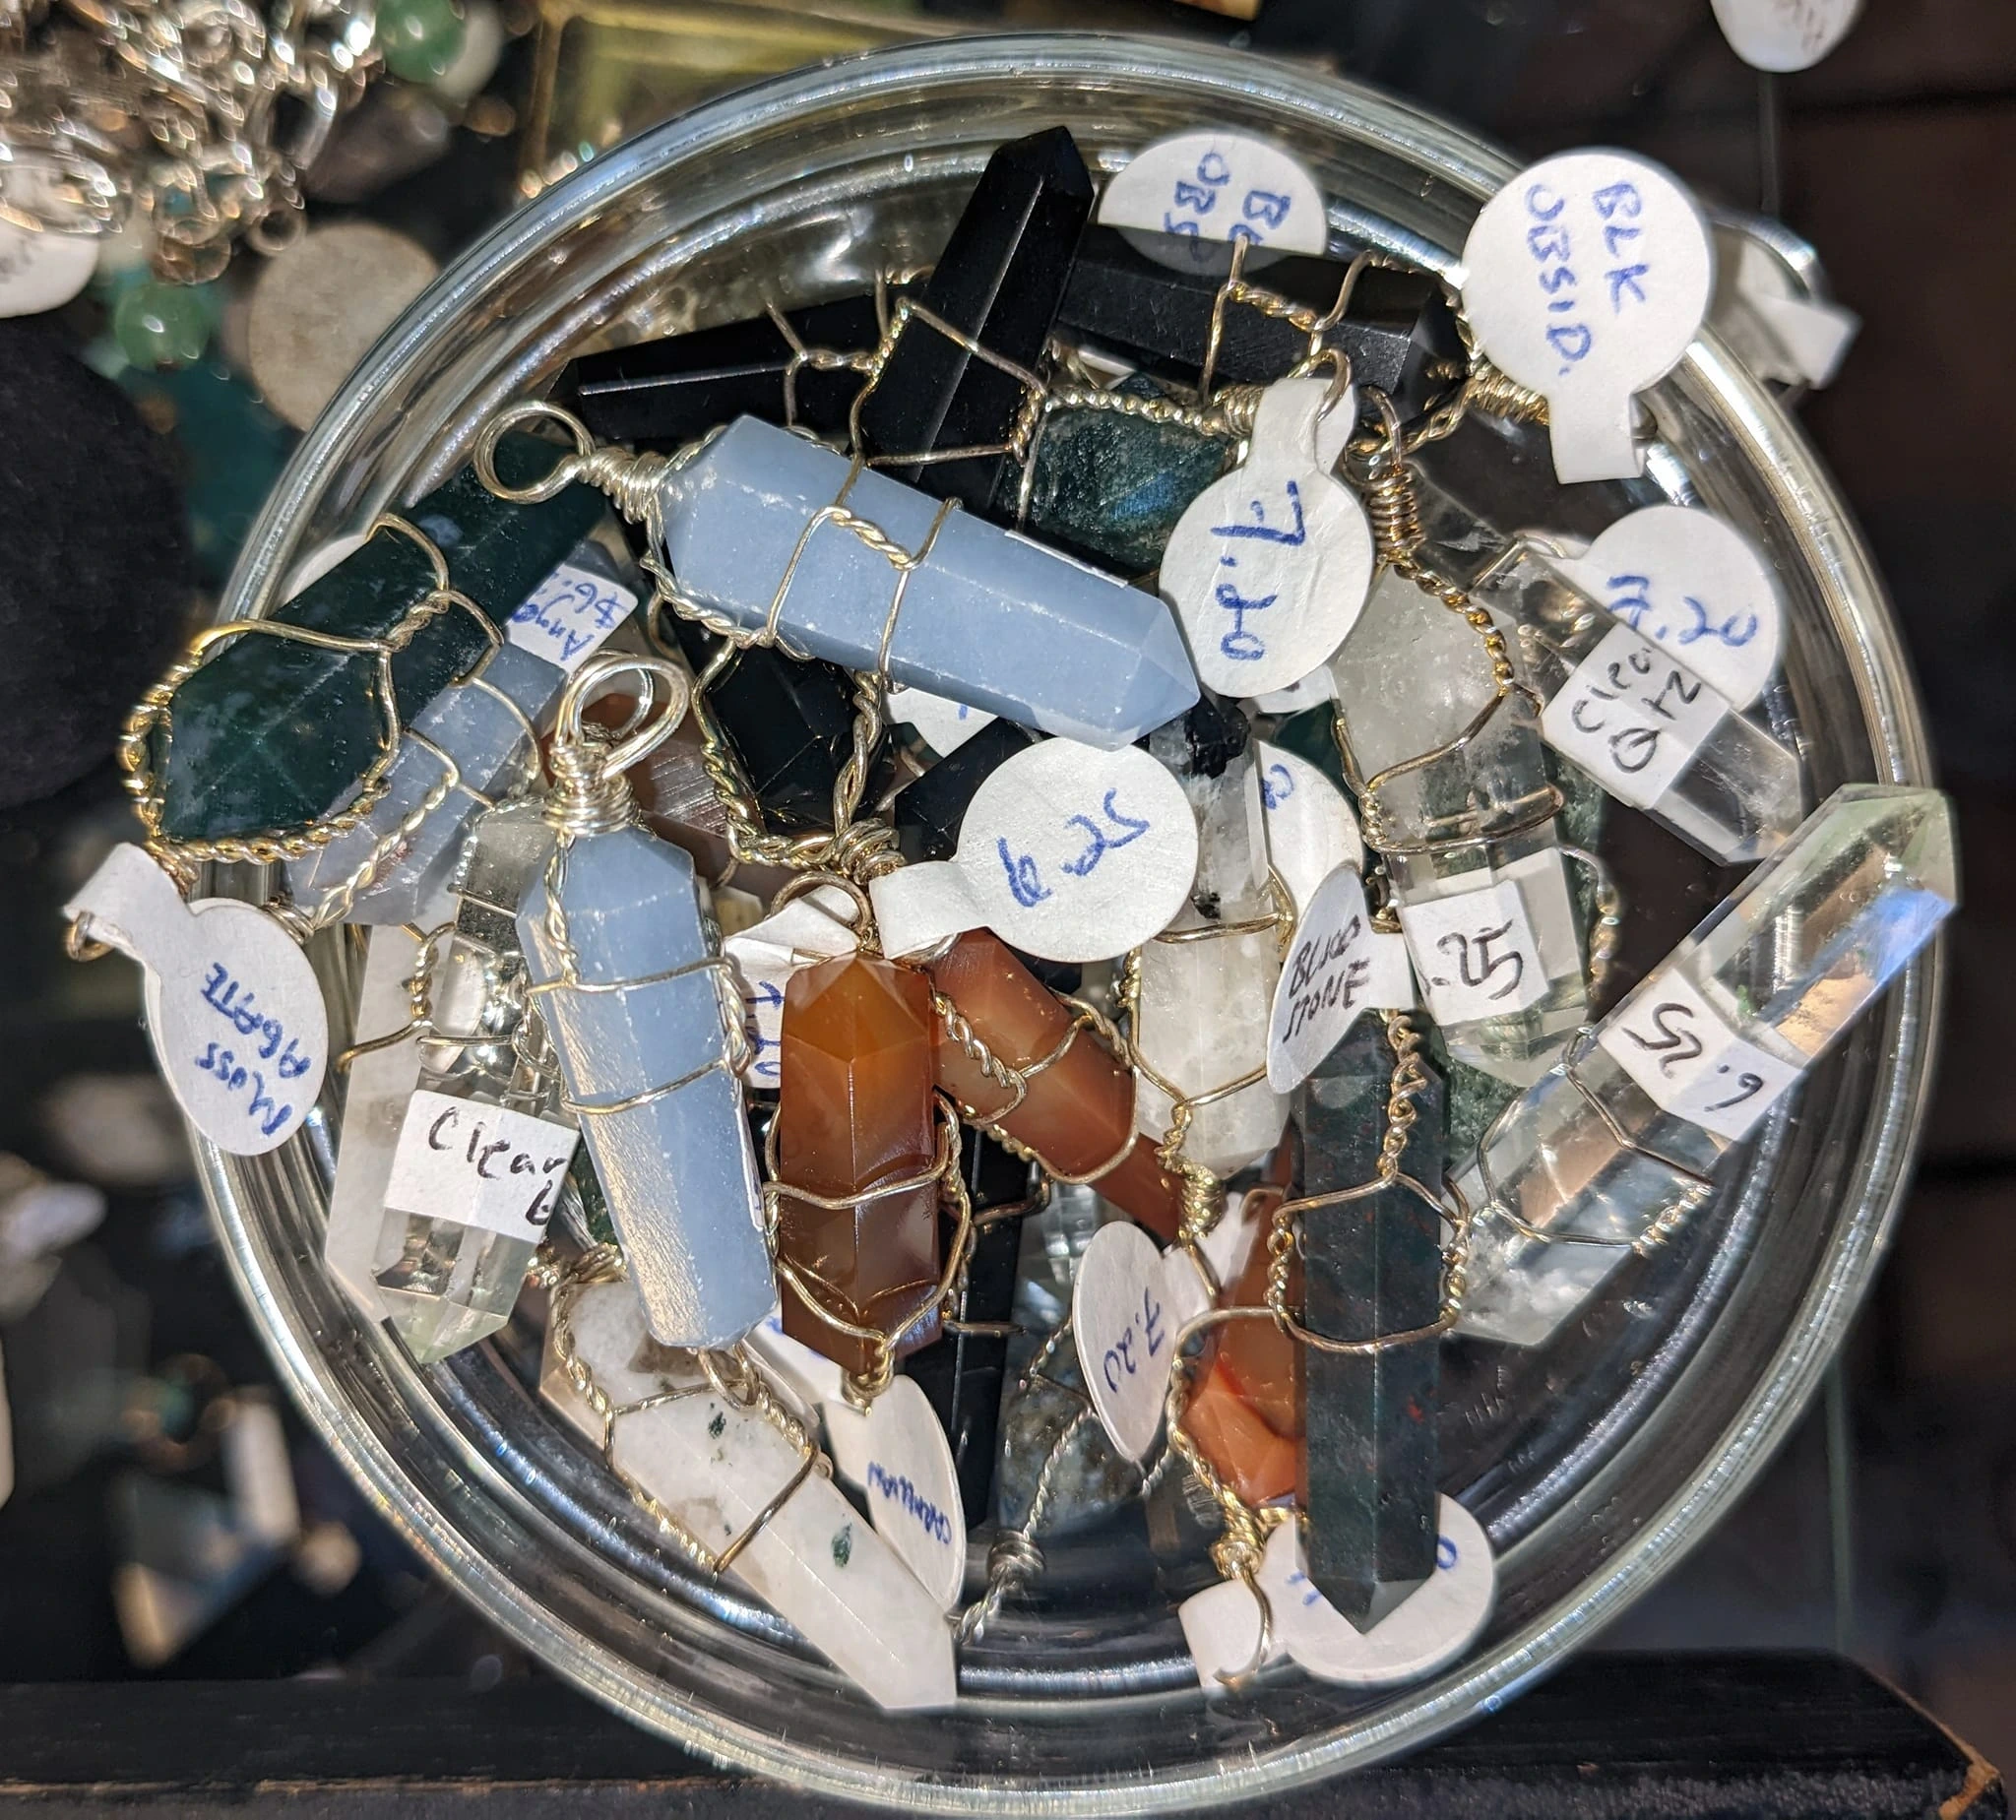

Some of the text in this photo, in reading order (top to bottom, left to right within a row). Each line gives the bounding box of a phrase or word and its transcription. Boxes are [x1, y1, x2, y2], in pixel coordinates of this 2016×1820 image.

[1524, 183, 1592, 376] OBSID.
[1592, 180, 1649, 318] BLK
[1210, 480, 1306, 660] 7.20
[201, 963, 312, 1078] AGATE
[1283, 957, 1370, 1043] STONE
[1621, 1002, 1765, 1112] 6.25
[428, 1106, 568, 1180] Clear
[1103, 1287, 1166, 1394] 7.20
